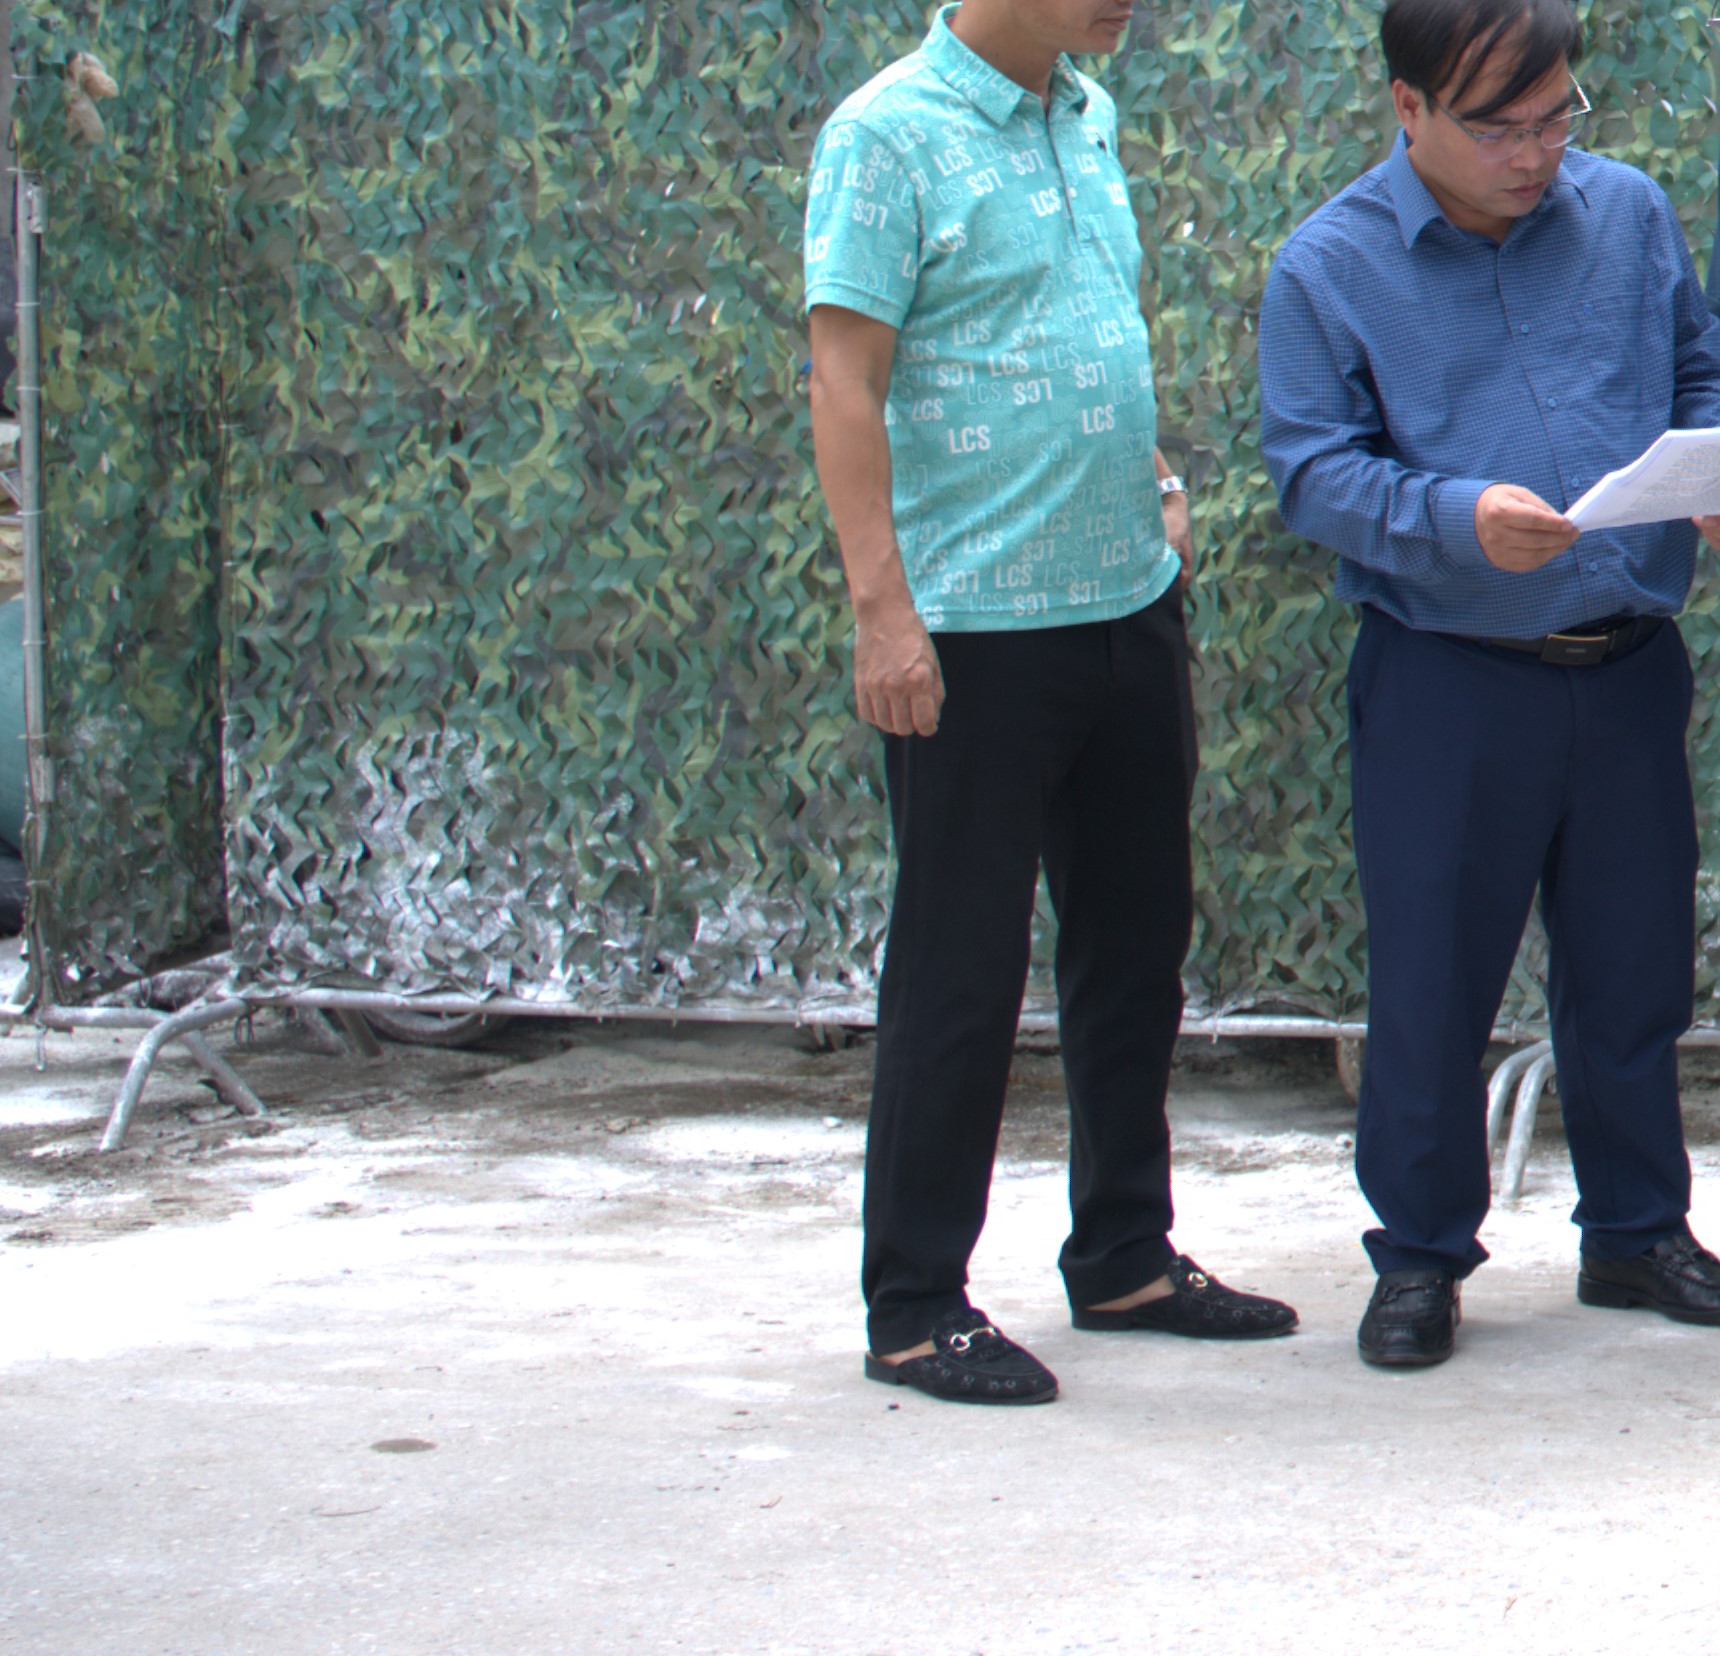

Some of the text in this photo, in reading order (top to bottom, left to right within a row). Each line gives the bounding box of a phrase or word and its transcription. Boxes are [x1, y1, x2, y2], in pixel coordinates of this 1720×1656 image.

[933, 145, 973, 177] LCS
[1010, 148, 1045, 175] LCS
[843, 162, 877, 192] LCS
[966, 167, 1003, 197] LCS
[853, 198, 888, 230] LCS
[1029, 187, 1061, 217] LCS
[952, 318, 991, 346] LCS
[1095, 319, 1124, 348] LCS
[937, 362, 975, 387] LCS
[988, 350, 1028, 377] LCS
[1075, 360, 1108, 389] LCS
[1012, 377, 1052, 405] LCS
[912, 398, 943, 422] LCS
[1082, 404, 1115, 435] LCS
[948, 424, 991, 454] LCS
[963, 530, 1002, 554] LCS
[1102, 538, 1130, 568] LCS
[941, 570, 979, 594] LCS
[995, 564, 1032, 589] LCS
[1013, 592, 1048, 617] LCS
[1069, 580, 1101, 606] LCS
